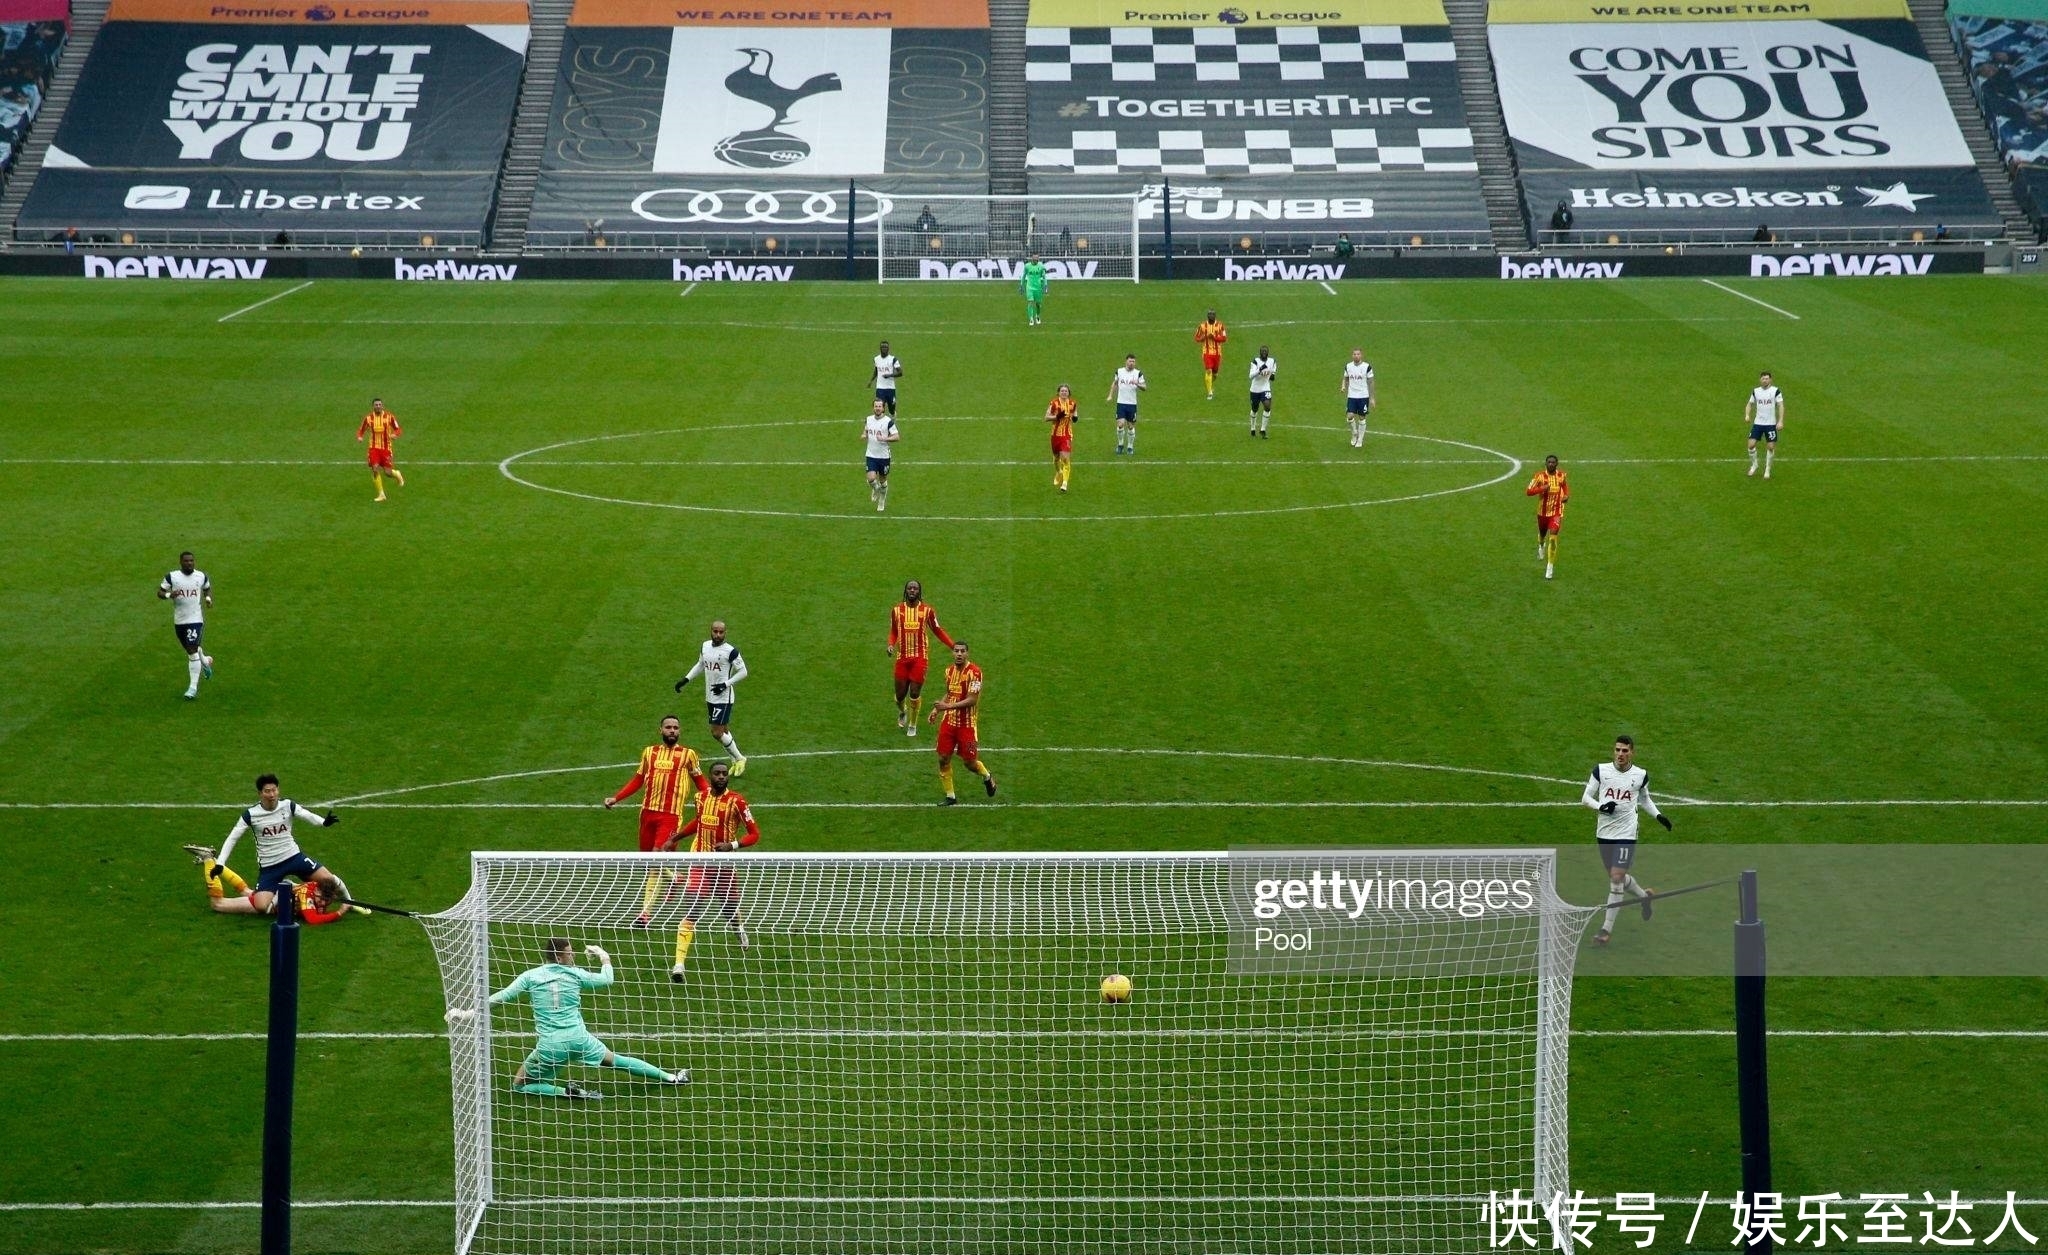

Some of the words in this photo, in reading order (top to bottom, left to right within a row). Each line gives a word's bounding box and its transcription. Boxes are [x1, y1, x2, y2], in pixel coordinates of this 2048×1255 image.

[210, 6, 298, 18] Premier
[343, 8, 430, 20] League
[676, 11, 714, 20] WE
[719, 11, 766, 20] ARE
[771, 11, 821, 20] ONE
[825, 11, 892, 21] TEAM
[1124, 11, 1210, 21] Premier
[1256, 11, 1342, 22] League
[1591, 7, 1630, 16] WE
[1635, 6, 1682, 15] ARE
[1687, 5, 1738, 15] ONE
[1741, 4, 1811, 14] TEAM
[1569, 46, 1748, 72] COME
[1765, 43, 1857, 70] ON
[171, 72, 425, 103] SMILE
[1574, 70, 1869, 124] YOU
[169, 100, 418, 122] WITHOUT
[162, 118, 412, 161] YOU
[1591, 124, 1891, 159] SPURS
[206, 188, 425, 211] Libertex
[1569, 186, 1843, 208] Heineken
[1138, 197, 1374, 220] FUN88
[178, 588, 198, 598] AIA
[186, 629, 198, 639] 24
[712, 707, 722, 718] 17
[1605, 787, 1632, 801] AIA
[261, 823, 288, 837] AIA
[1619, 847, 1629, 861] 11
